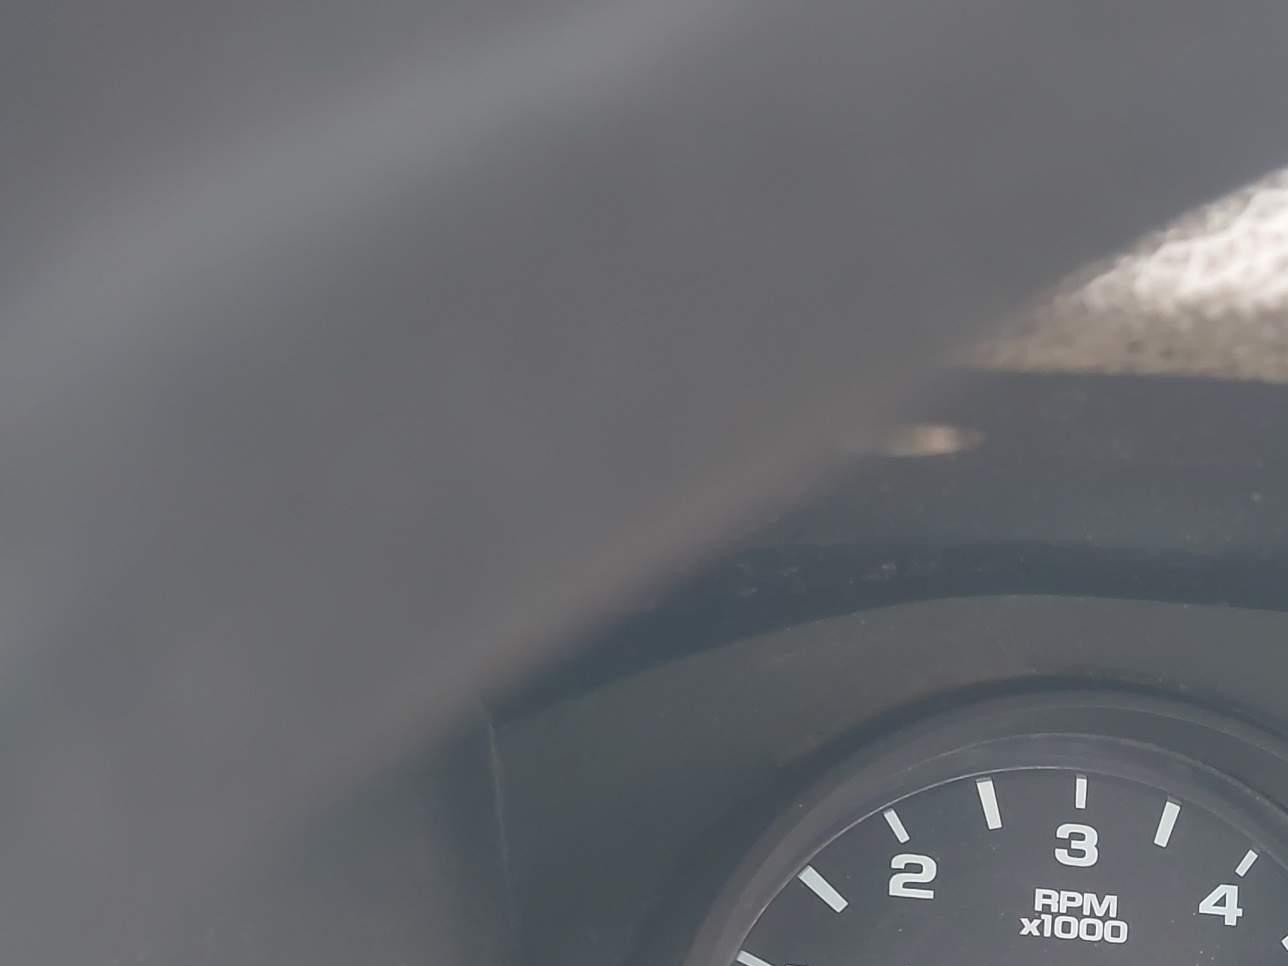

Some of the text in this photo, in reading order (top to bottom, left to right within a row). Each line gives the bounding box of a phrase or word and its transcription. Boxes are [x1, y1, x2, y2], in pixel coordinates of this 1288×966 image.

[1055, 823, 1099, 868] 3
[888, 854, 938, 900] 2
[1034, 888, 1118, 918] RPM
[1198, 884, 1243, 926] 4
[1019, 914, 1129, 944] x1000
